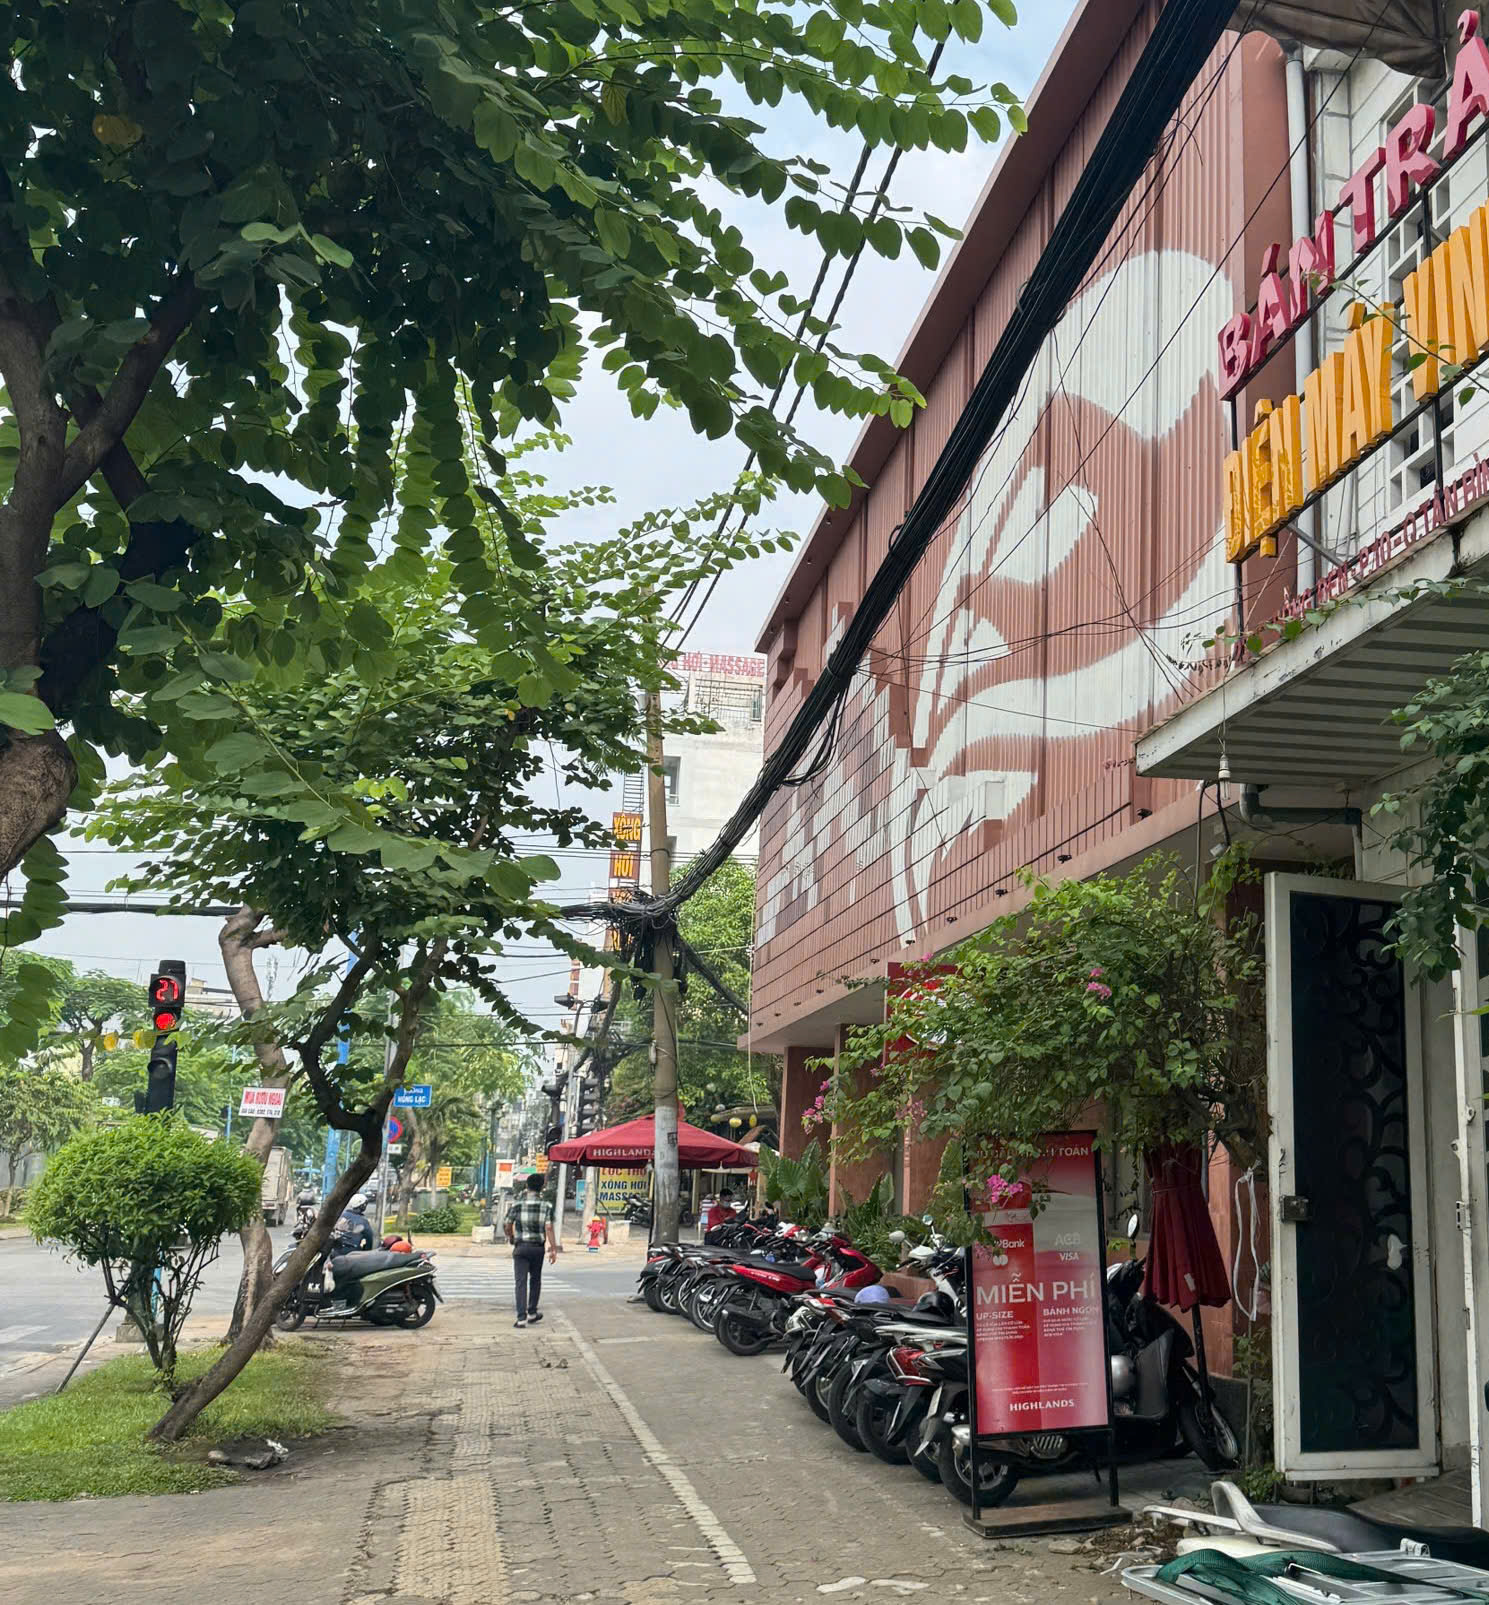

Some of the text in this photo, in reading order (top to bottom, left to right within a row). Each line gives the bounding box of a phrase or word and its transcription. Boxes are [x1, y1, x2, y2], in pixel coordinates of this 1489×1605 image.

[1304, 302, 1393, 494] MÁY
[1403, 195, 1489, 402] VIN
[710, 654, 765, 677] MASSAGE
[1059, 1252, 1080, 1262] VISA
[976, 1271, 1095, 1305] MIỄN PHÍ
[976, 1310, 1014, 1321] UP-SIZE
[1043, 1305, 1070, 1317] BÁNH
[1009, 1400, 1075, 1412] HIGHLANDS
